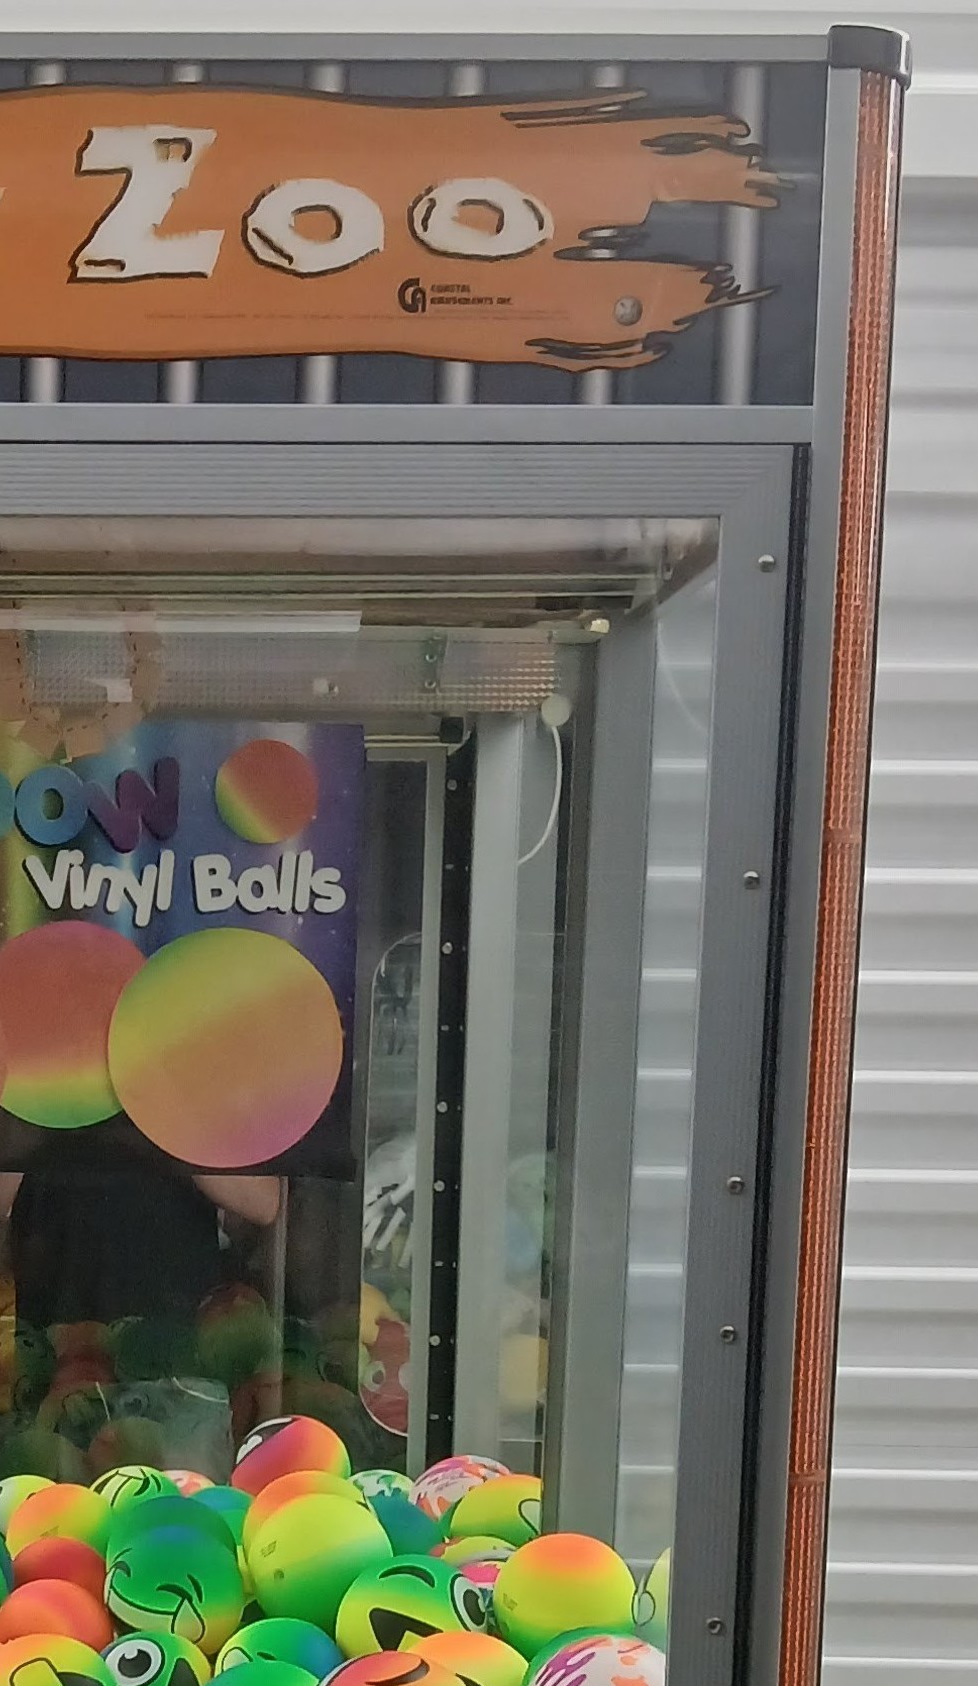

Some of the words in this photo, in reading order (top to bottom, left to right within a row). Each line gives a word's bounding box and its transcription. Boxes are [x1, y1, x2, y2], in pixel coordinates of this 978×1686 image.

[67, 123, 556, 283] Zoo
[24, 848, 174, 926] Vinyl
[194, 850, 347, 915] Balls
